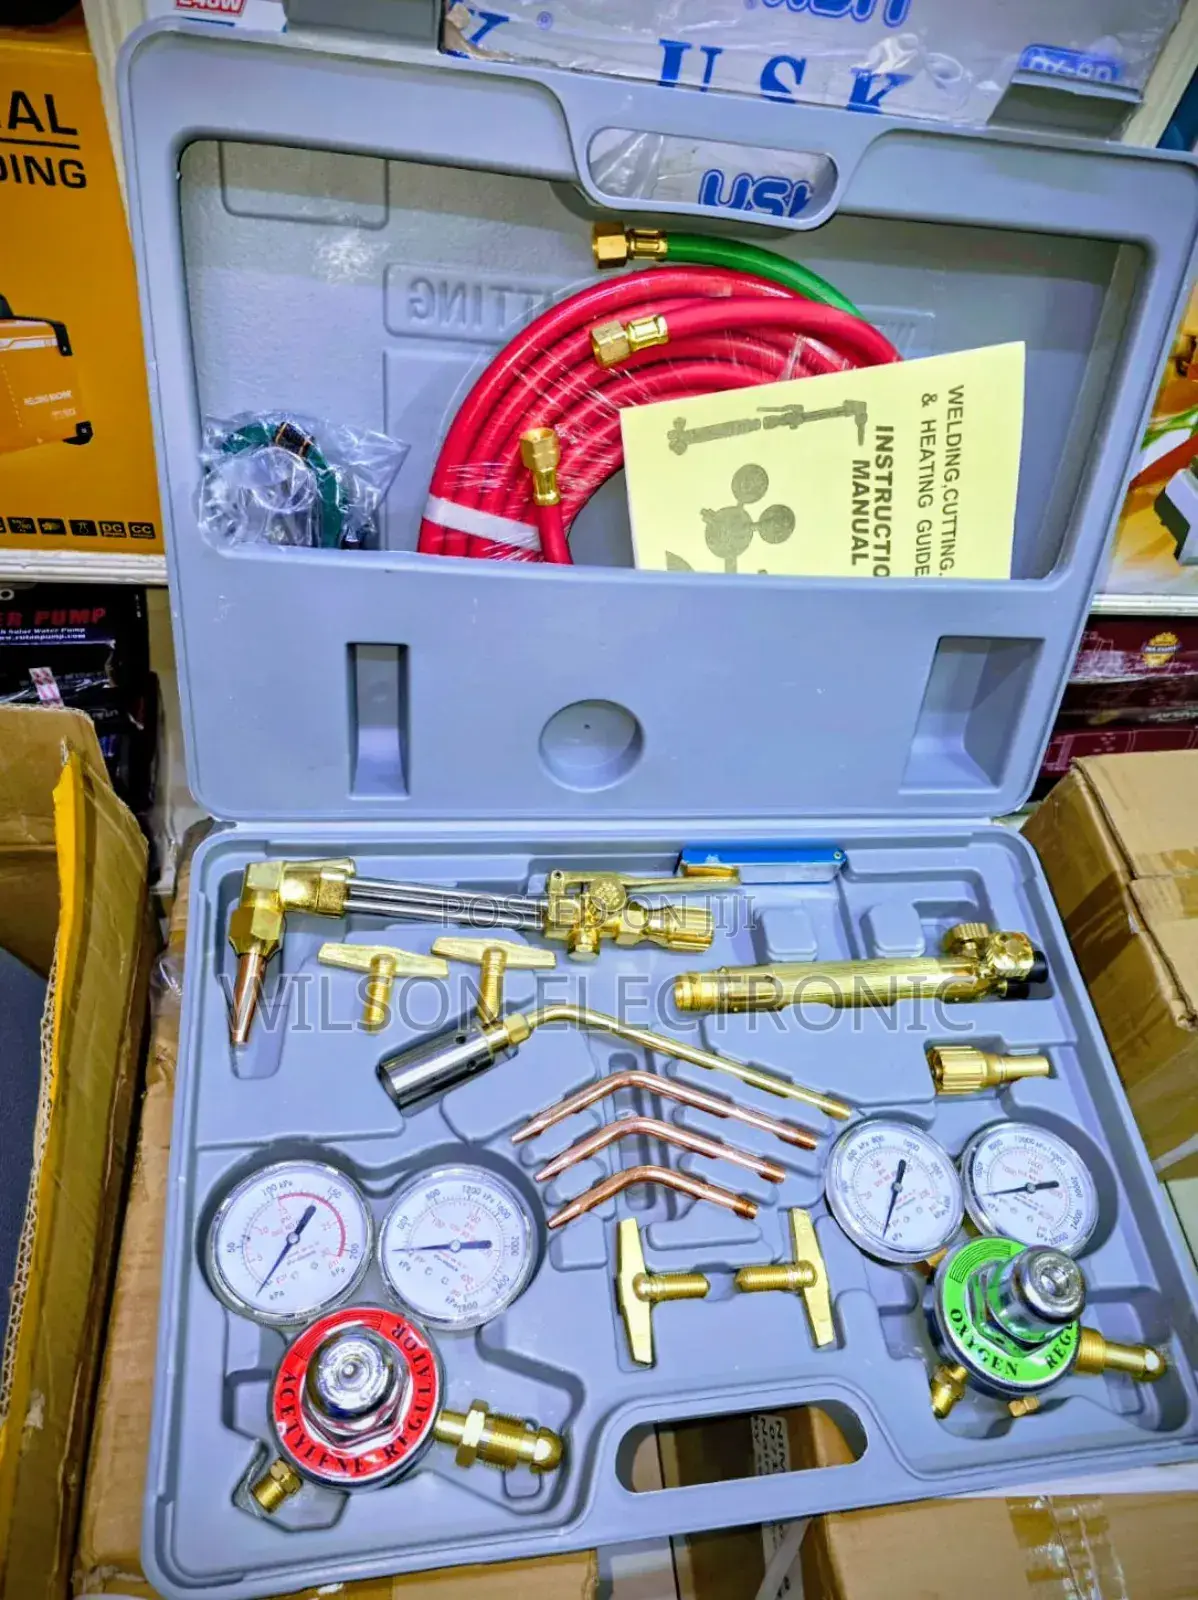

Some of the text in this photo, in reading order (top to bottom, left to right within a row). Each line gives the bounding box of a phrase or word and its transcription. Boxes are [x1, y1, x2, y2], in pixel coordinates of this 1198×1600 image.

[917, 418, 937, 509] HEATING
[851, 459, 870, 566] MANUAL
[914, 519, 933, 577] GUIDE
[34, 608, 107, 626] PUMP
[950, 1308, 1019, 1377] OXYGEN
